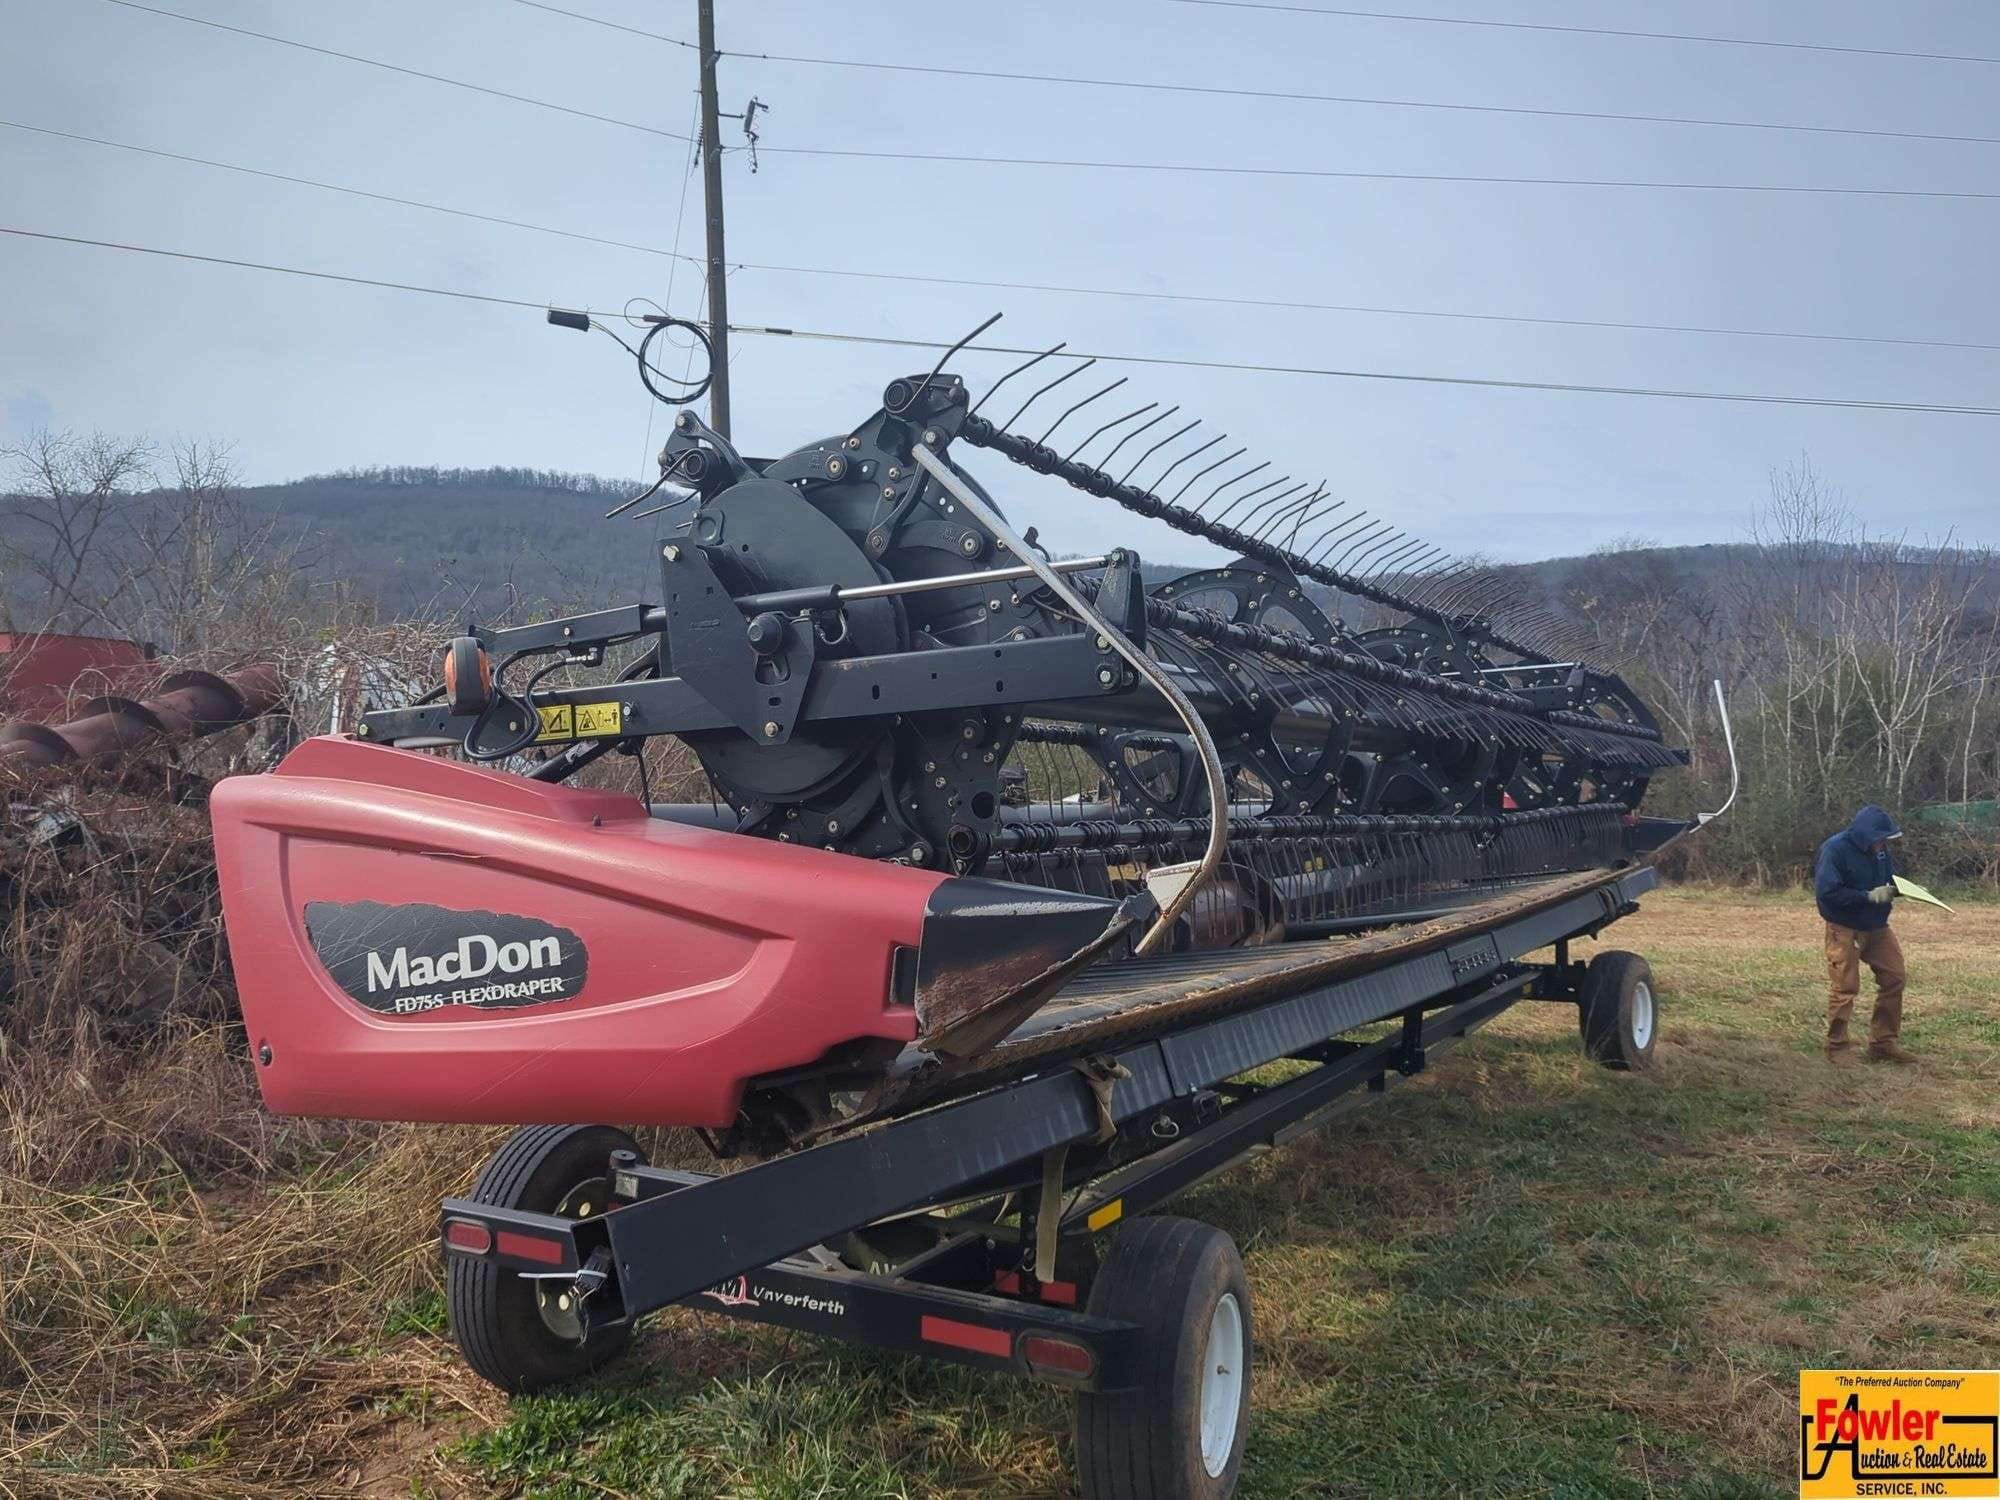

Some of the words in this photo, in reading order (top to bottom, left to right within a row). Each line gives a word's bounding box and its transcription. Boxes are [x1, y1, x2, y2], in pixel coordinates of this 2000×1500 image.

[367, 934, 562, 992] MacDon
[452, 977, 565, 1006] FLEXDRAPER
[753, 1285, 845, 1316] Unverferth
